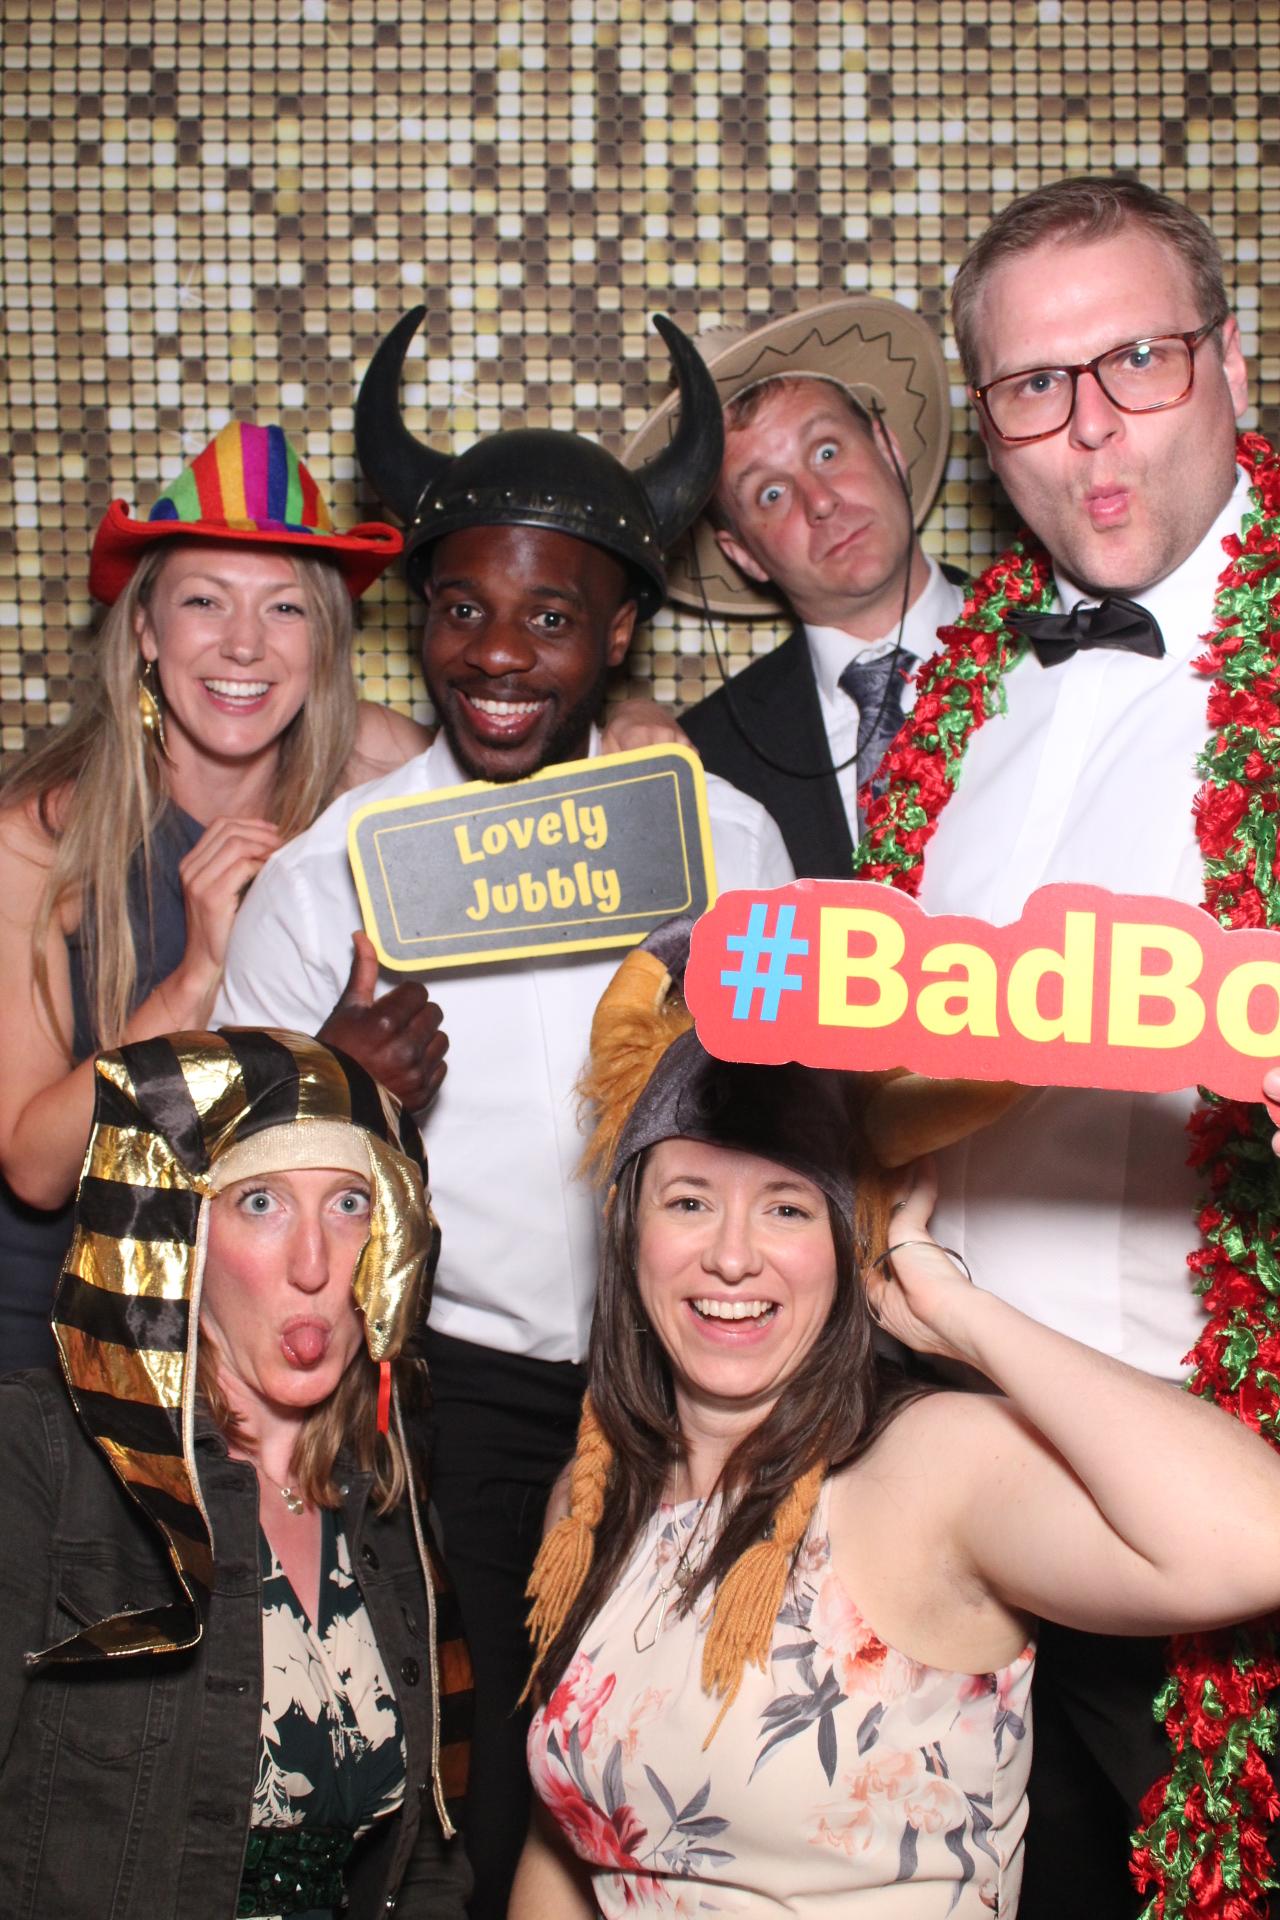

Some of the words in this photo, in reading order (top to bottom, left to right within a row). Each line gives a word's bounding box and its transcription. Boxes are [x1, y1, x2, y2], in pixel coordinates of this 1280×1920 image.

[454, 799, 608, 864] Lovely
[466, 862, 621, 921] Jubbly
[720, 903, 1280, 1058] #BadBo
